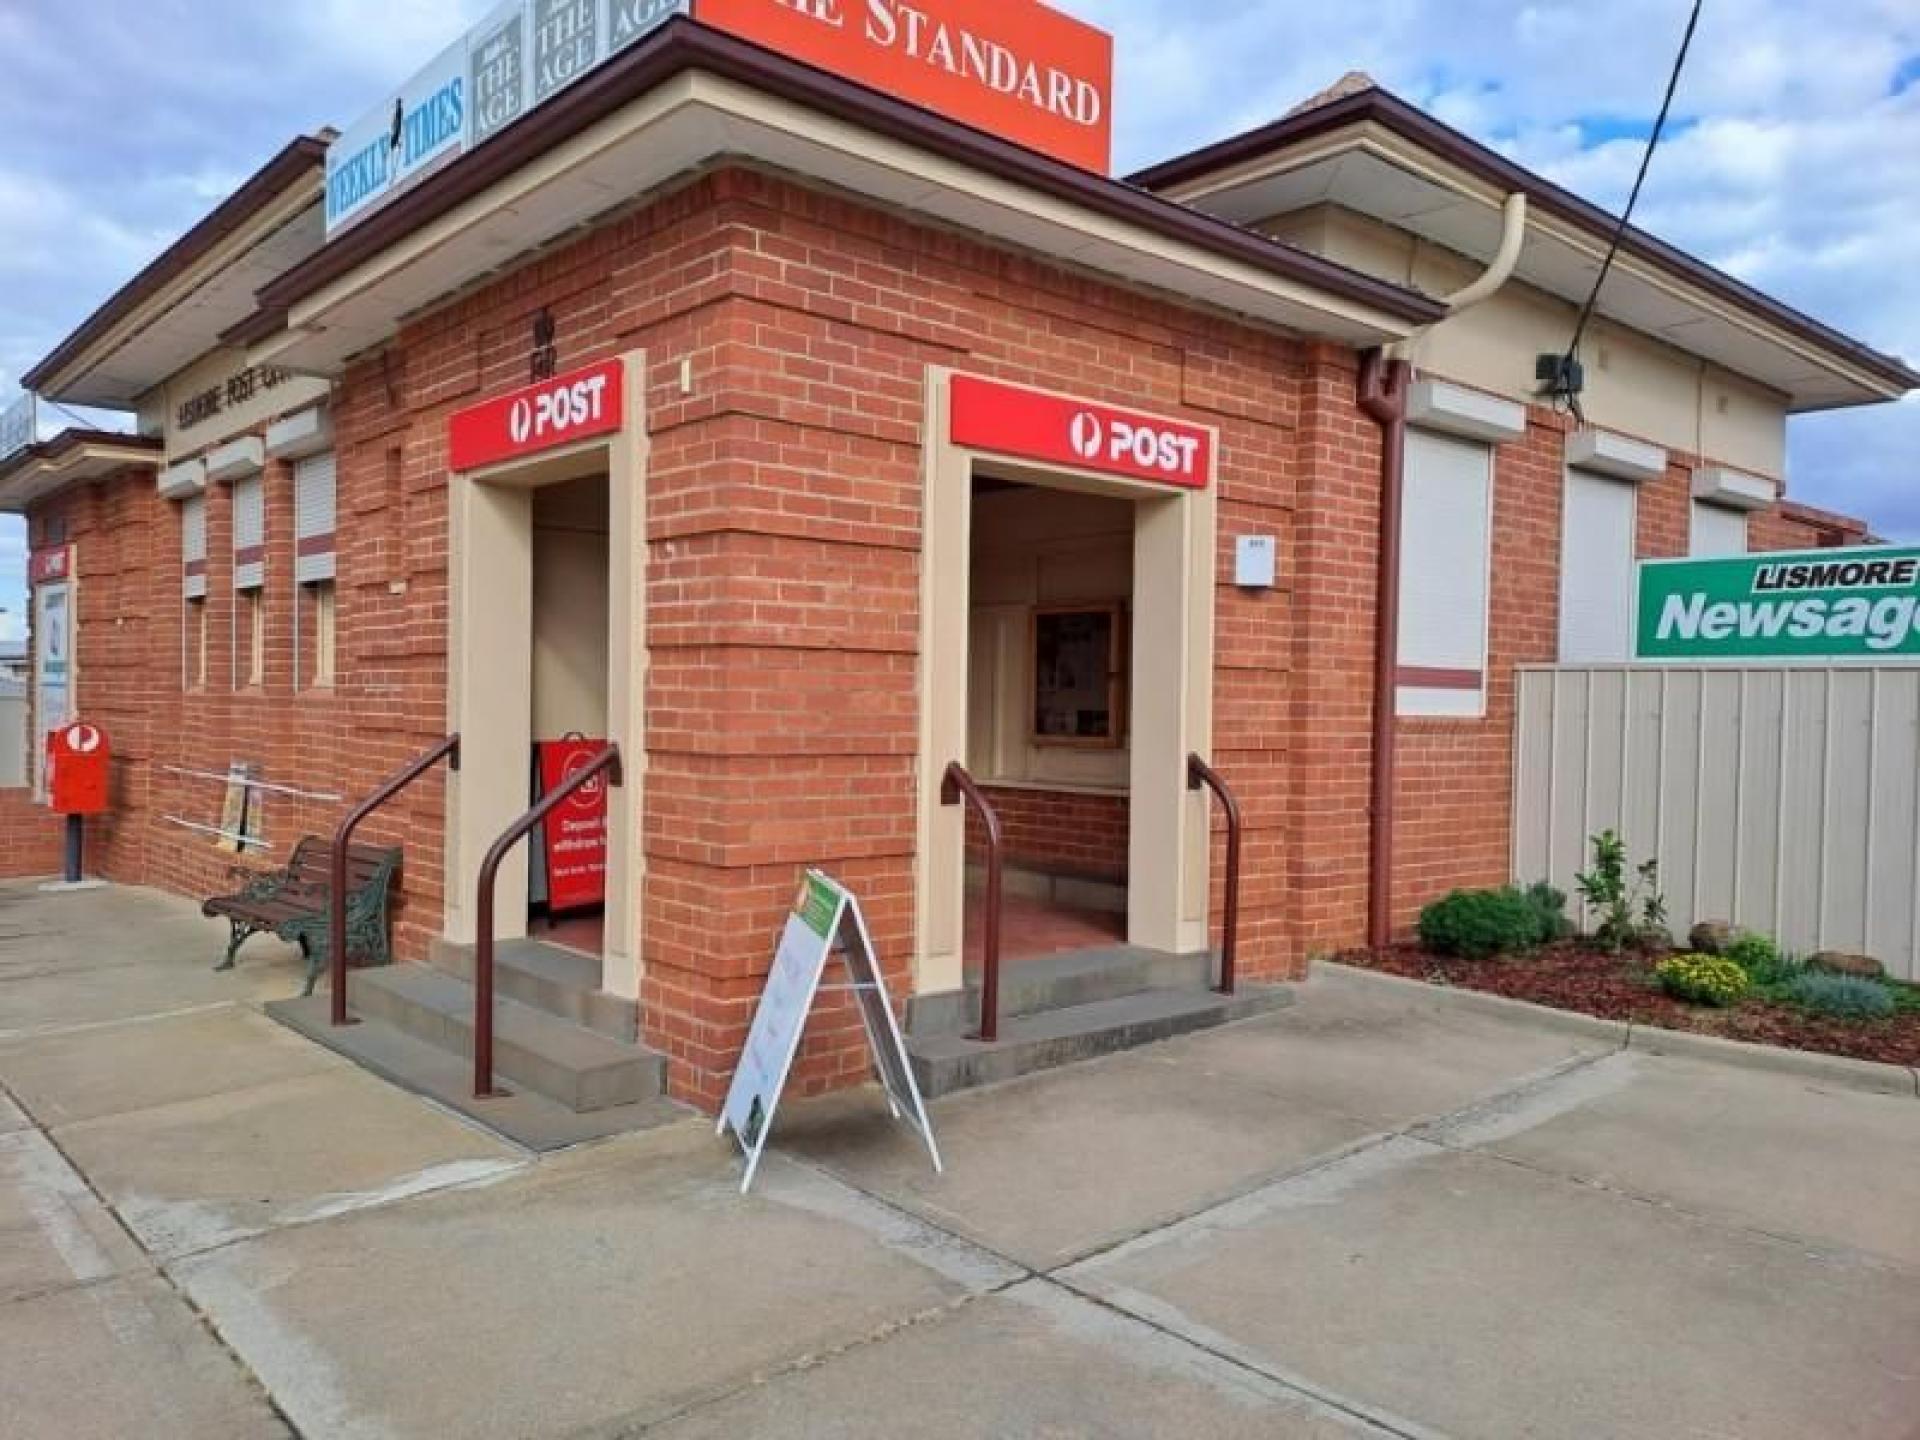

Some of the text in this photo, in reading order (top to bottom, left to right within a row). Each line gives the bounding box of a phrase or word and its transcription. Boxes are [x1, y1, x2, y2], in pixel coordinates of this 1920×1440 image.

[537, 0, 594, 57] THE
[476, 47, 520, 106] THE
[537, 33, 594, 96] AGE
[866, 0, 1101, 126] STANDARD
[403, 76, 463, 169] TIMES
[476, 84, 520, 134] AGE
[535, 374, 607, 436] POST
[1109, 420, 1199, 474] POST
[1755, 559, 1918, 590] LISMORE
[1655, 592, 1920, 650] Newsag
